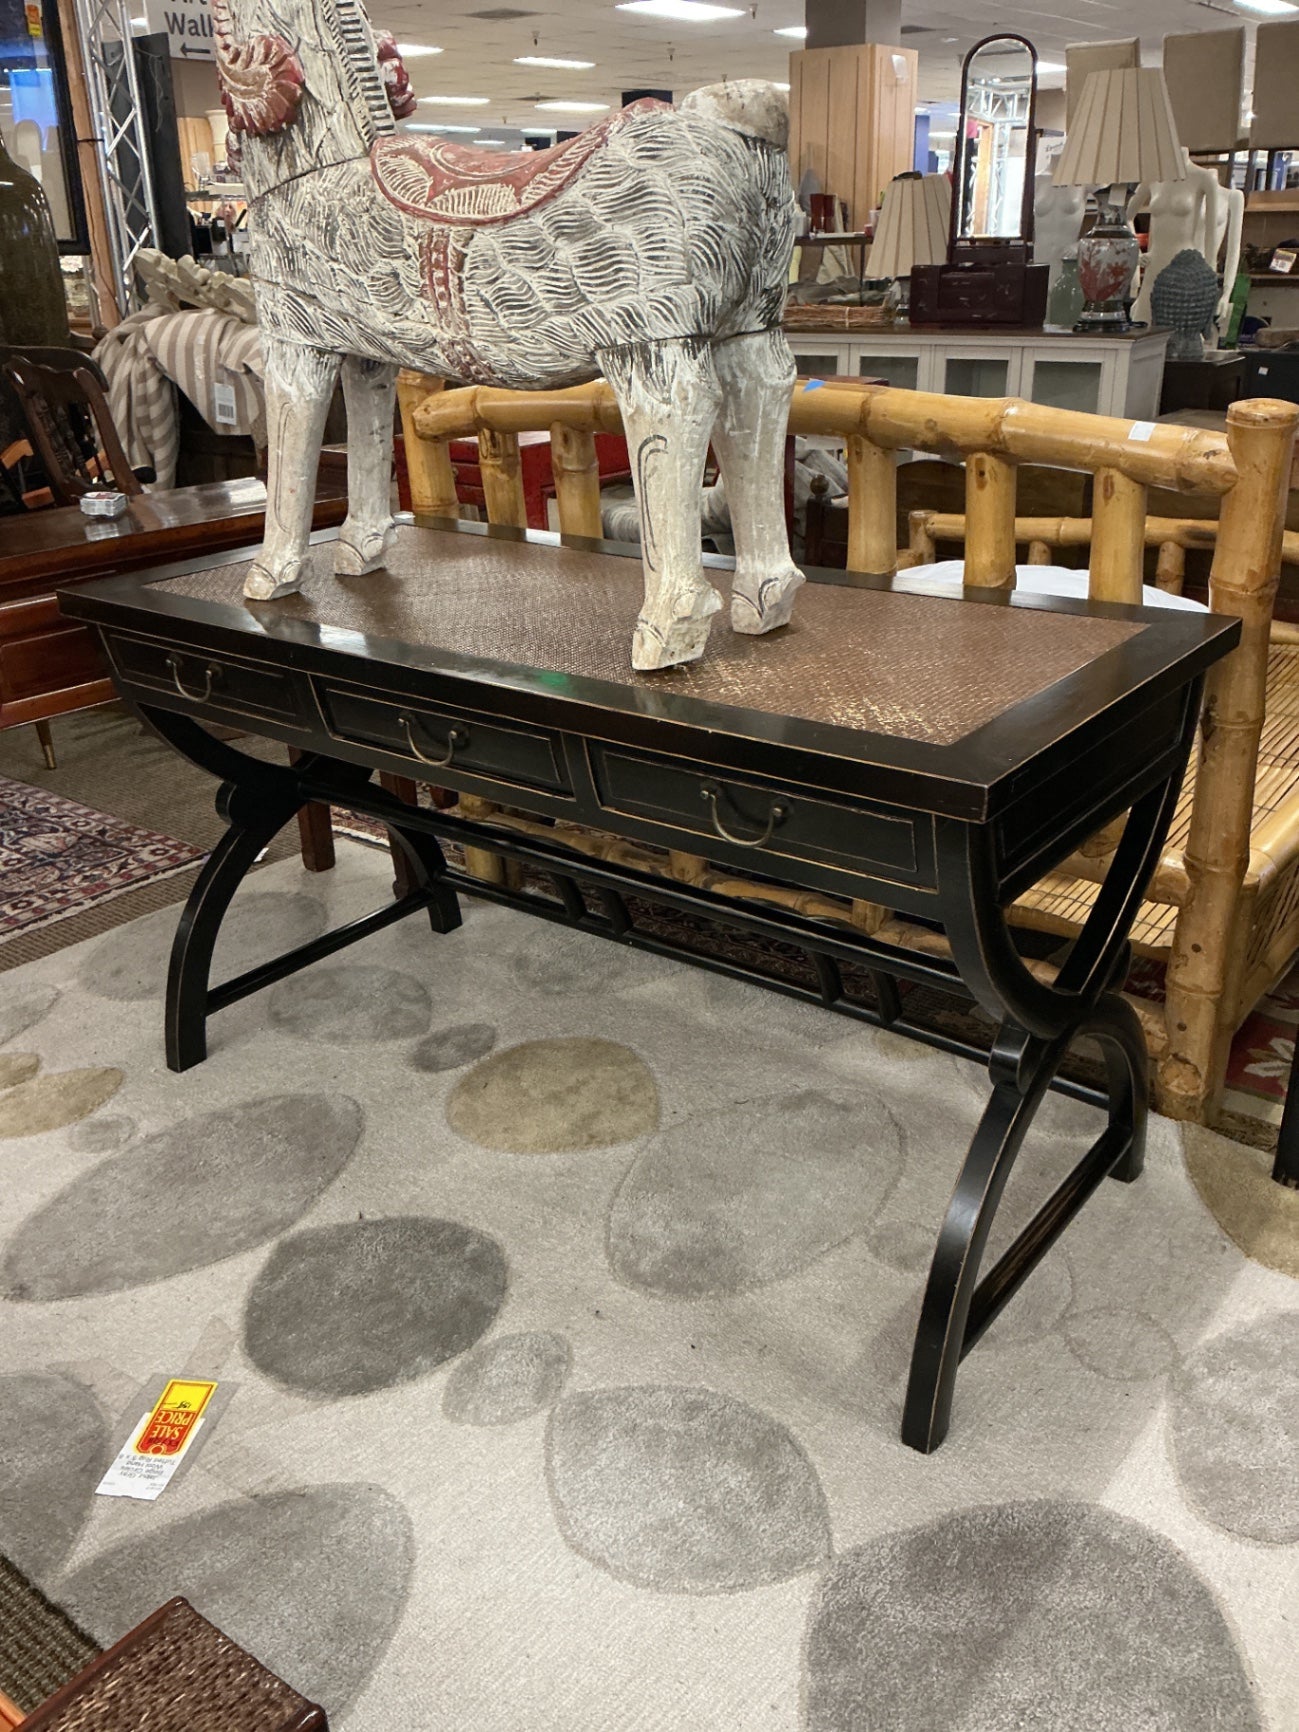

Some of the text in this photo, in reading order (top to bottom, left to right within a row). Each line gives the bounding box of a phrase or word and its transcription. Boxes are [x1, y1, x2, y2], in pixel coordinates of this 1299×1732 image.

[164, 11, 214, 38] Wall
[154, 1411, 193, 1426] PRICE
[150, 1425, 184, 1440] SALE
